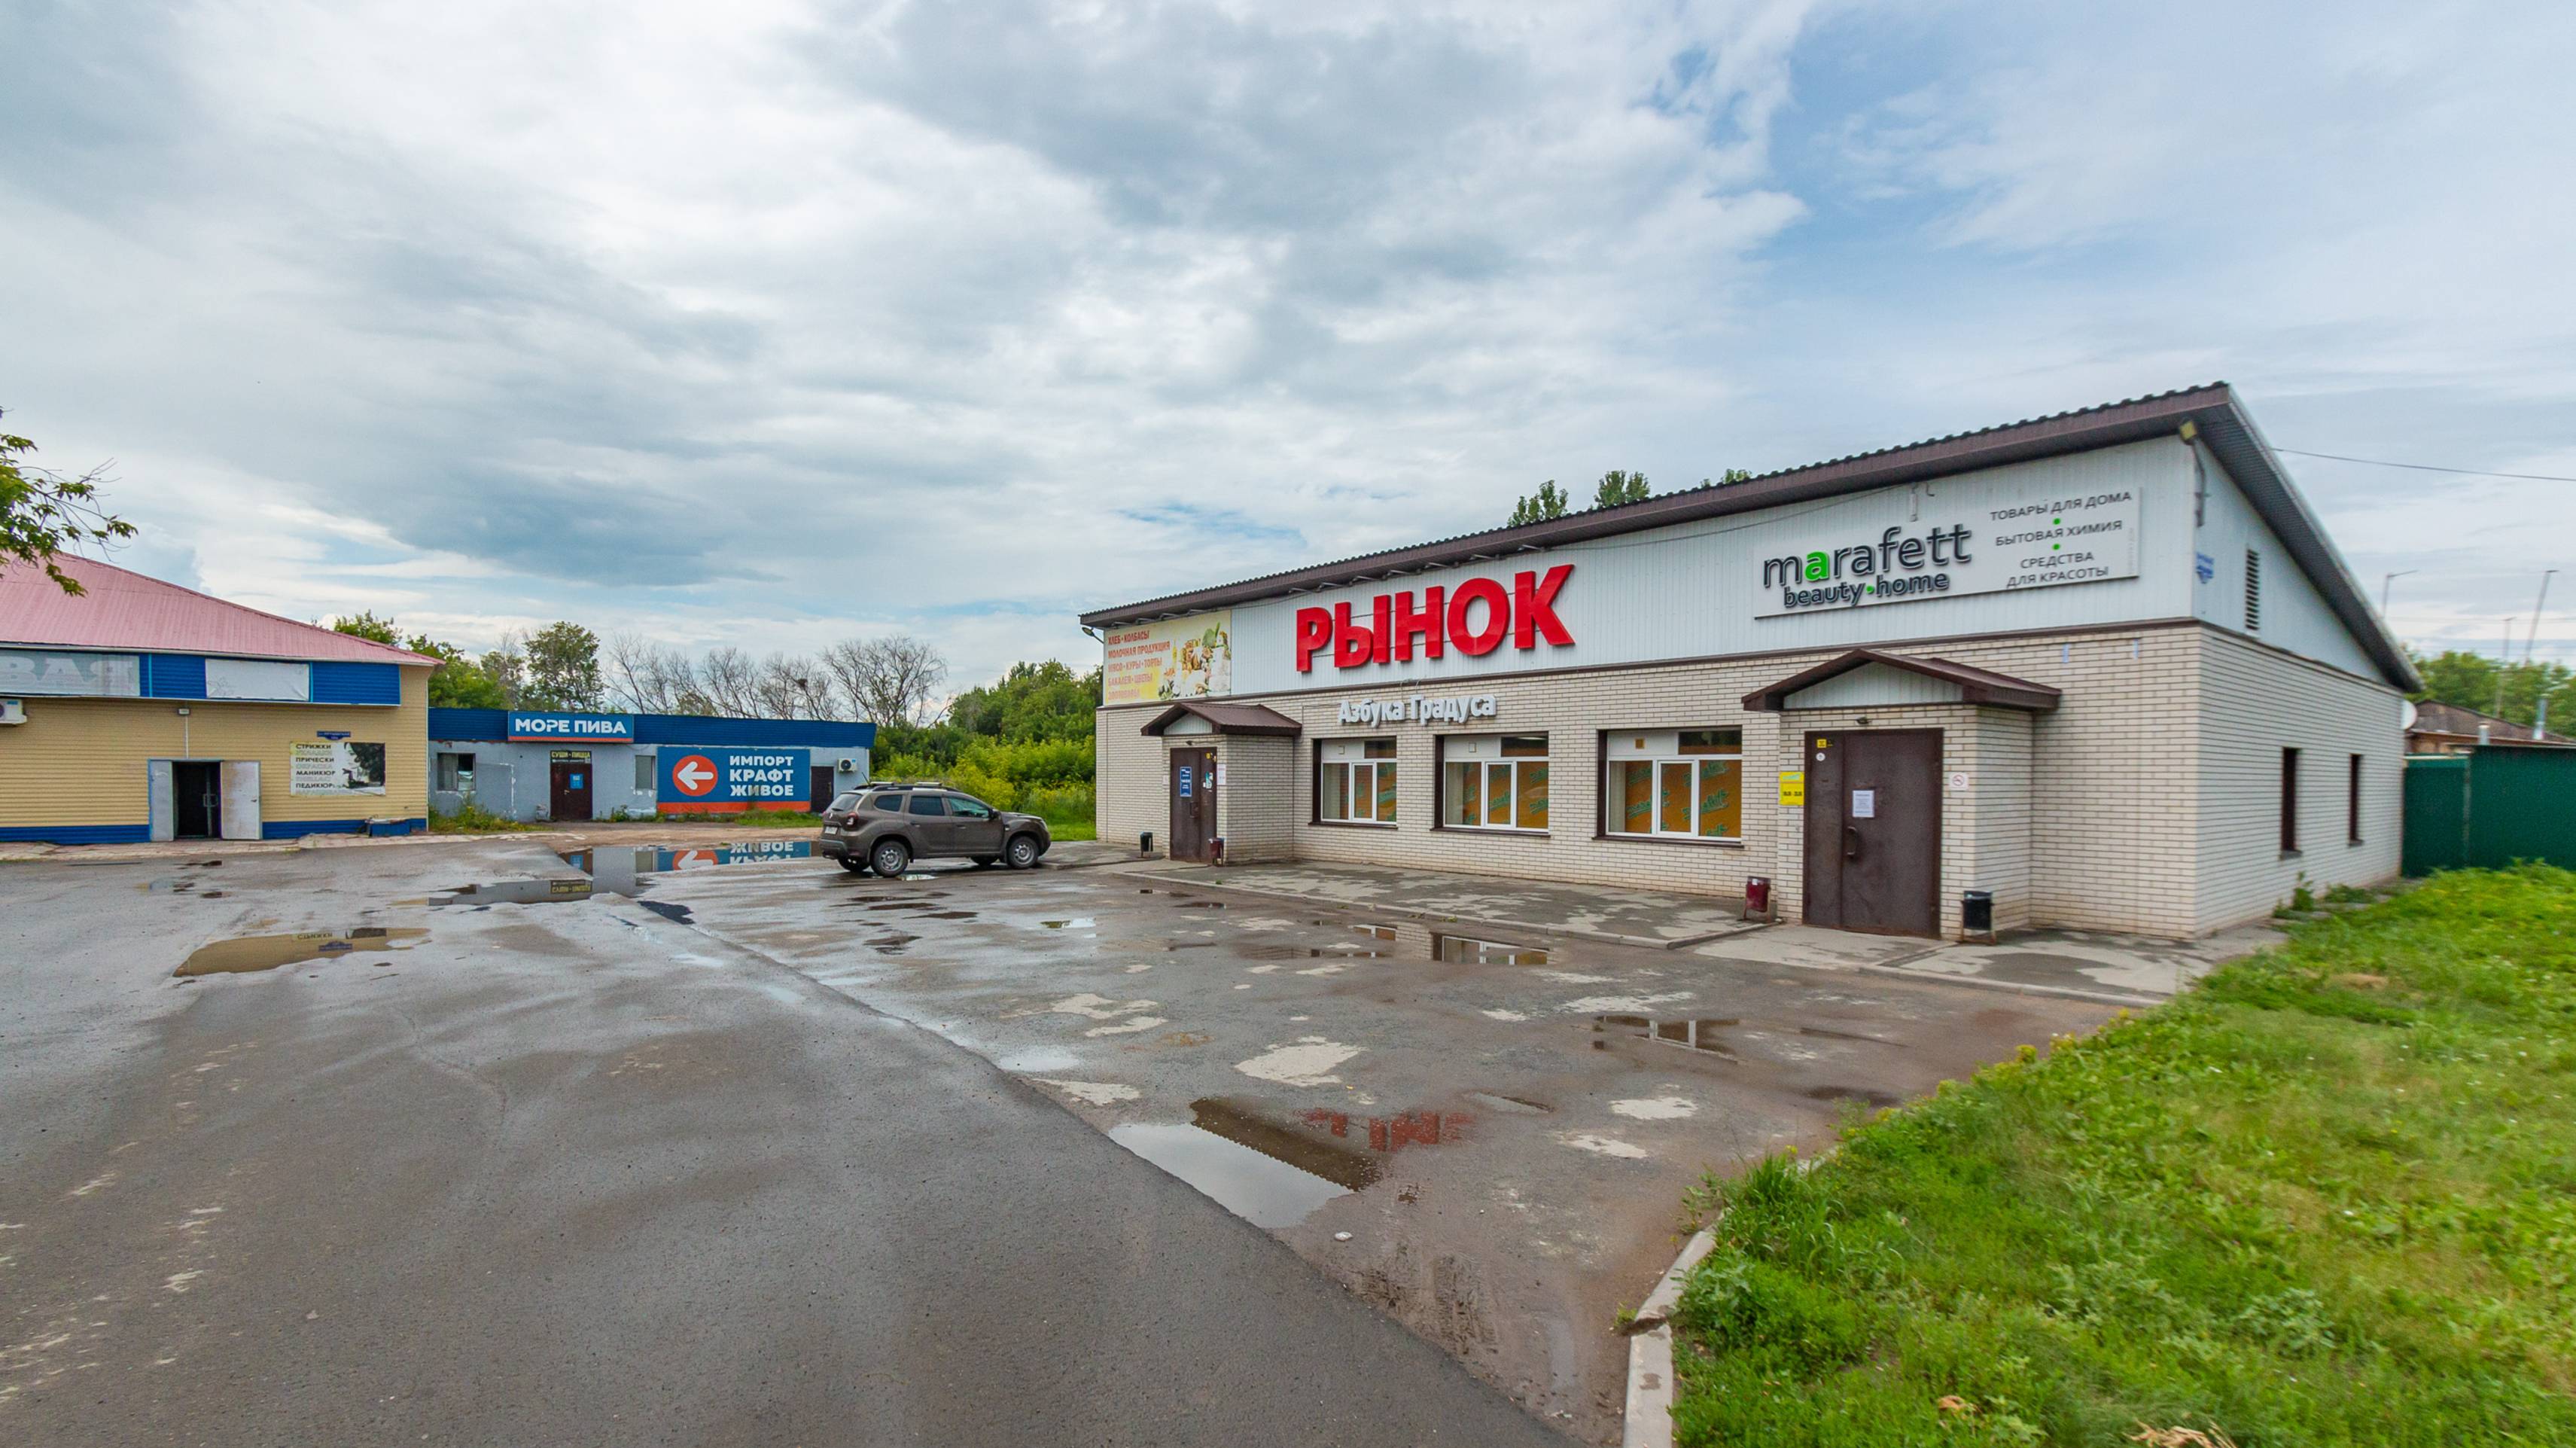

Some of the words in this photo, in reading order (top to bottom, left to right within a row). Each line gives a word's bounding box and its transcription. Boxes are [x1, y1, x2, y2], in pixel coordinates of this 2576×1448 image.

[1990, 504, 2048, 521] ТОВАРЫ
[2050, 498, 2083, 514] ДЛЯ
[2084, 492, 2132, 510] ДОМА
[1996, 529, 2063, 546] БЫТОВАЯ
[2066, 520, 2123, 536] ХИМИЯ
[1764, 523, 1972, 589] marafett
[2020, 552, 2095, 569] СРЕДСТВА
[2006, 574, 2037, 589] ДЛЯ
[2039, 566, 2109, 583] КРАСОТЫ
[1296, 564, 1576, 672] РЫНОК
[1338, 698, 1406, 729] Азбука
[1409, 694, 1497, 727] Градуса
[515, 718, 570, 733] МОРЕ
[574, 720, 627, 734] ПИВА
[729, 755, 794, 767] ИМПОРТ
[729, 768, 794, 783] КРАФТ
[729, 785, 794, 797] ЖИВОЕ
